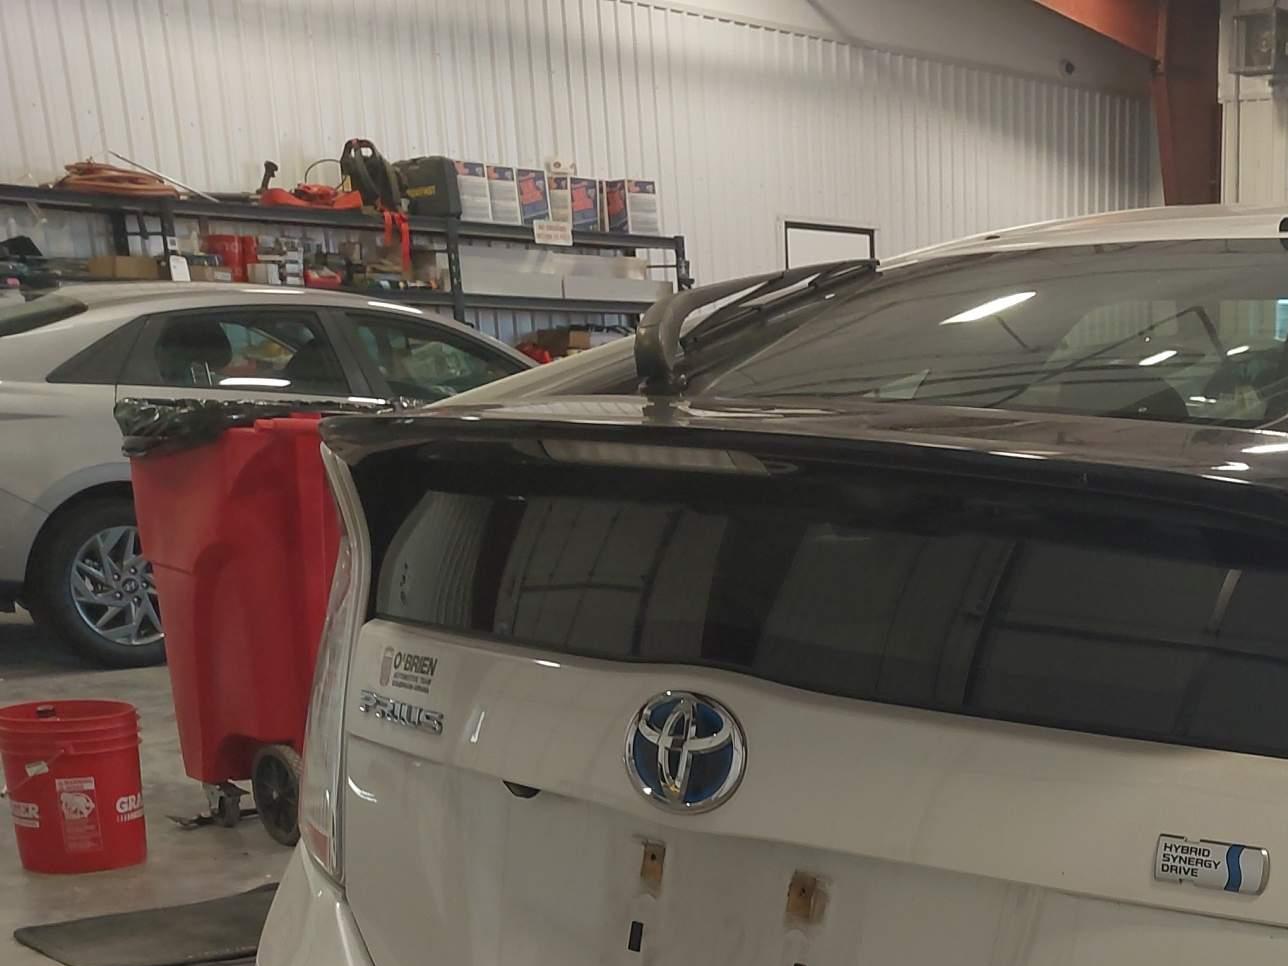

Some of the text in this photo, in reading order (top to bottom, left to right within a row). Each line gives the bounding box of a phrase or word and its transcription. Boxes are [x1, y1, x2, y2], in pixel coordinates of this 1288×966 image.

[393, 651, 438, 676] O'BRIEN
[360, 689, 444, 736] PRIUS
[1163, 842, 1211, 858] HYBRID
[1161, 863, 1199, 877] DRIVE
[1162, 853, 1221, 870] SYNERGY
